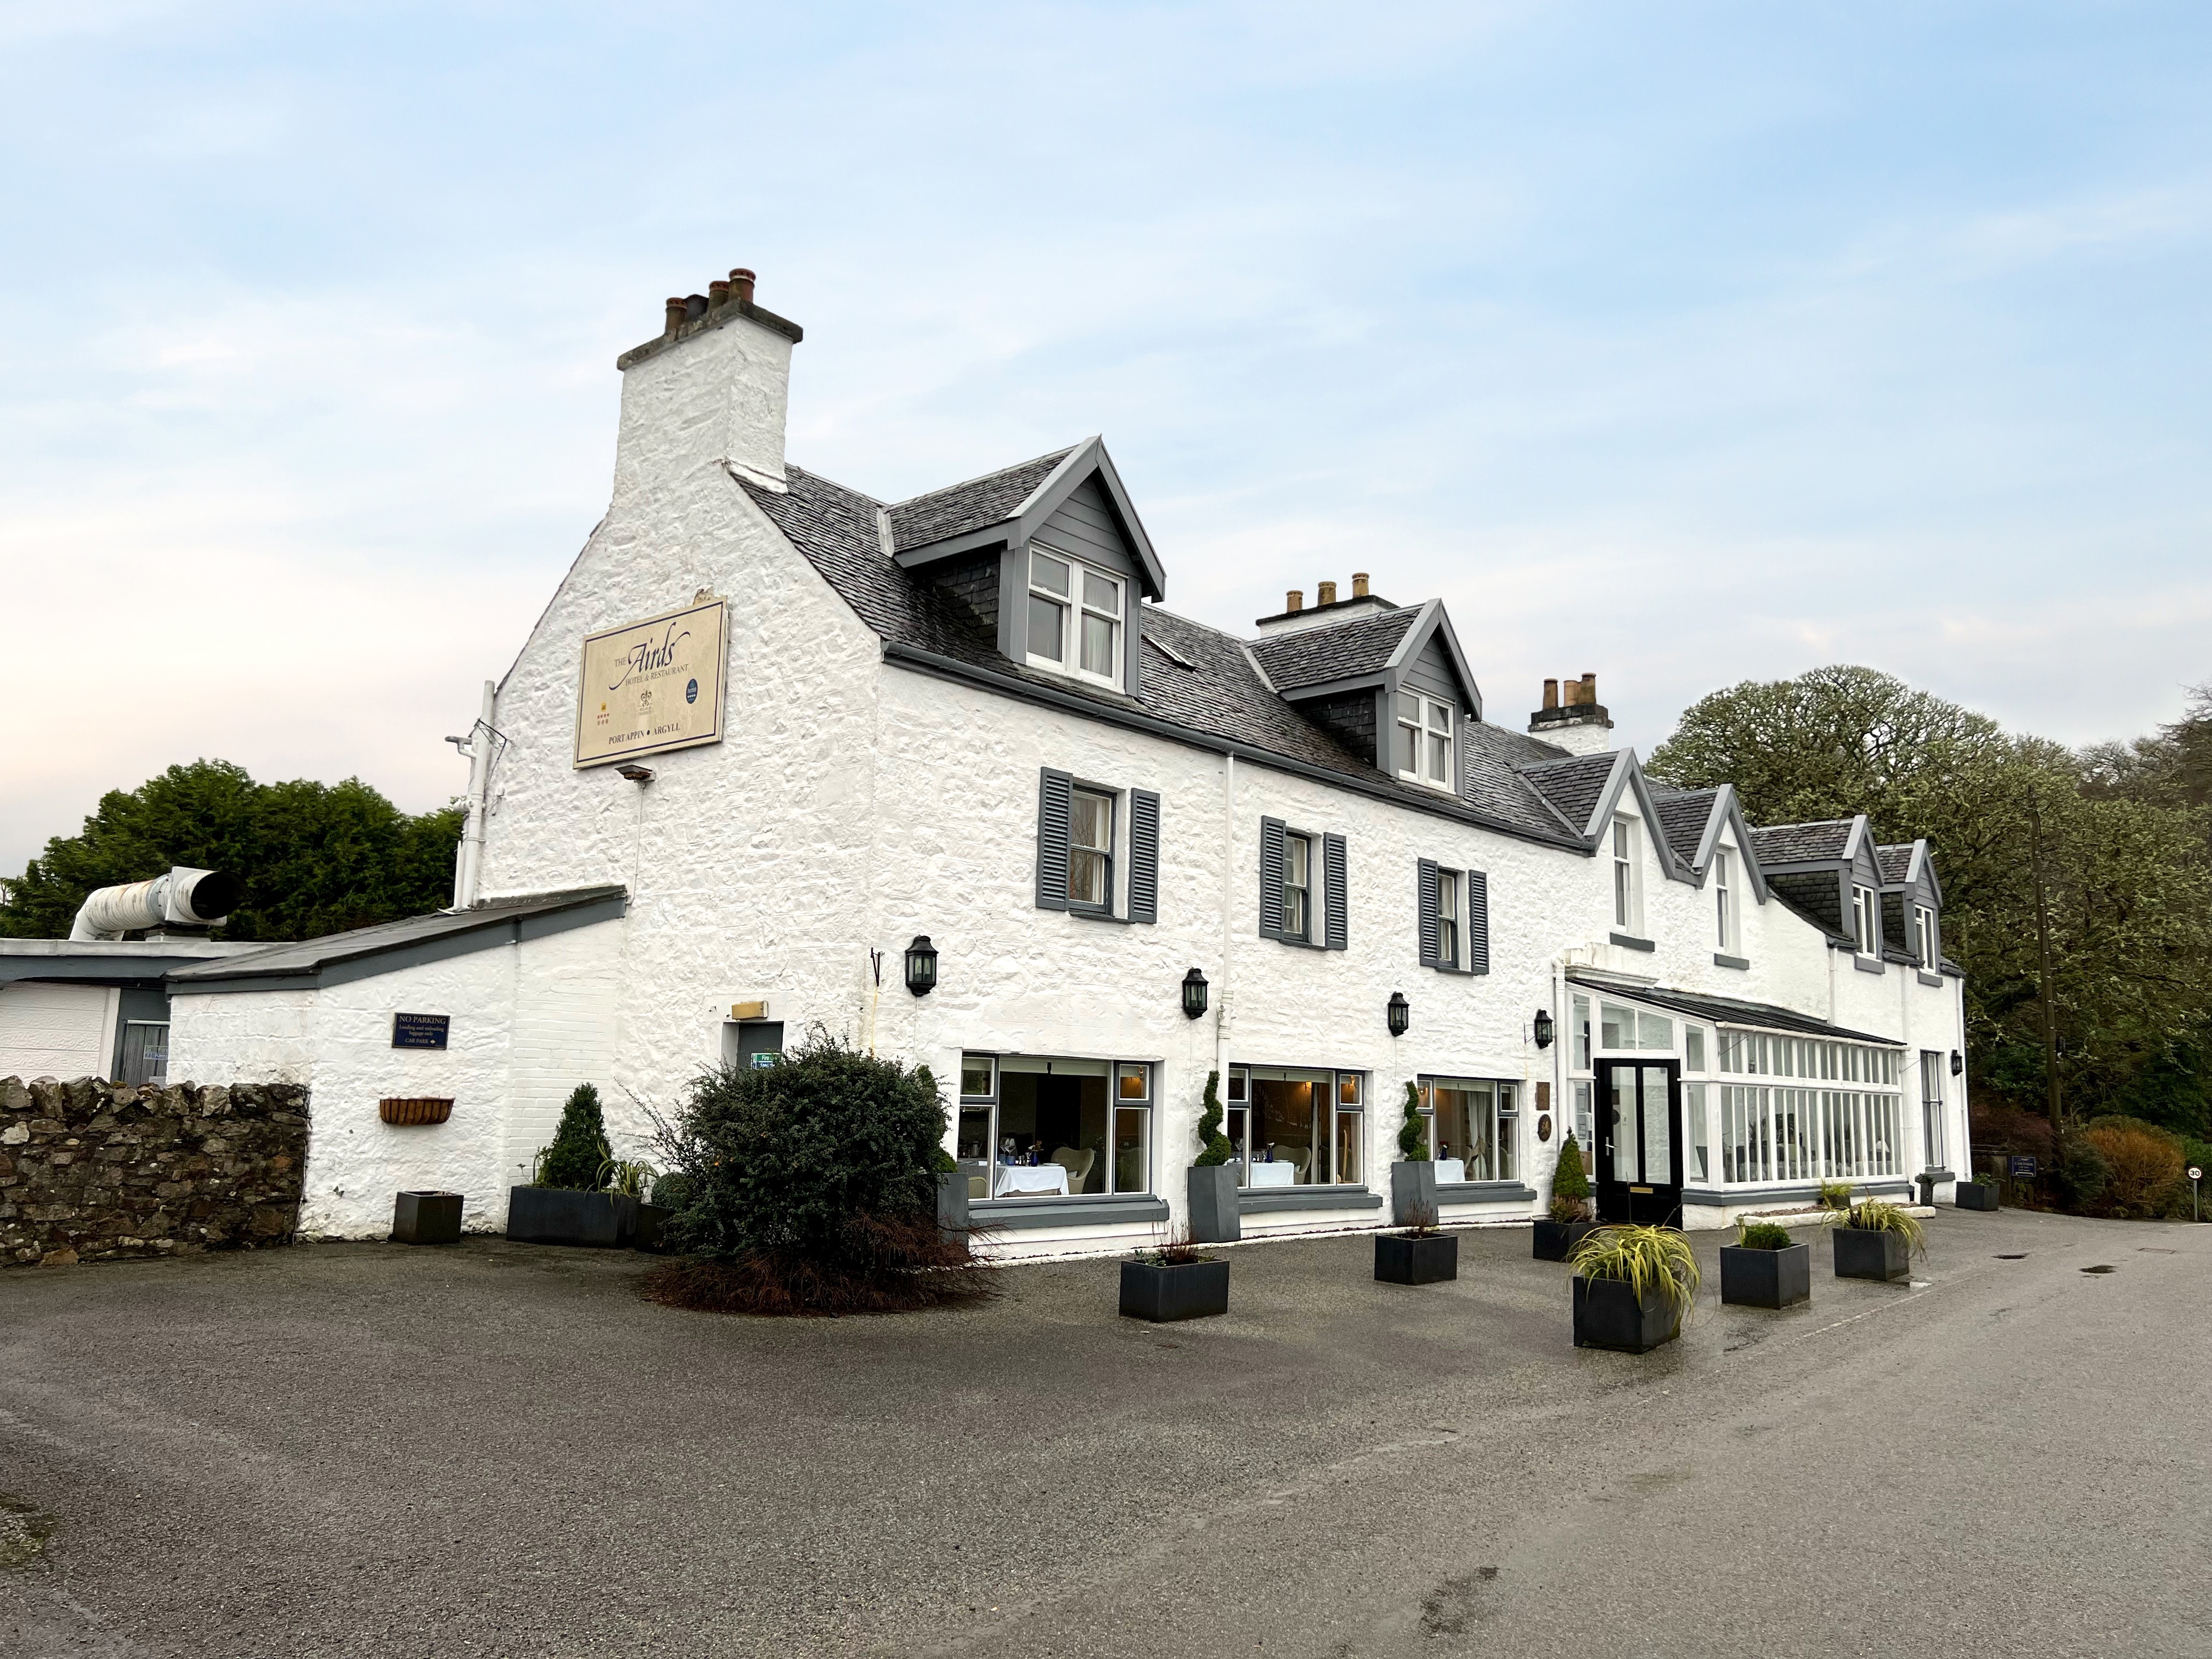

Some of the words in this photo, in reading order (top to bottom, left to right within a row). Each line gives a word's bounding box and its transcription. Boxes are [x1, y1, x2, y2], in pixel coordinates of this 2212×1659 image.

[609, 622, 691, 690] Airds
[614, 657, 627, 668] THE
[625, 674, 644, 686] HOTEL
[645, 673, 649, 681] &
[651, 664, 689, 680] RESTAURANT
[608, 733, 625, 744] PORT
[626, 730, 645, 741] APPIN
[653, 723, 680, 736] ARGYLL
[413, 1016, 446, 1024] PARKING
